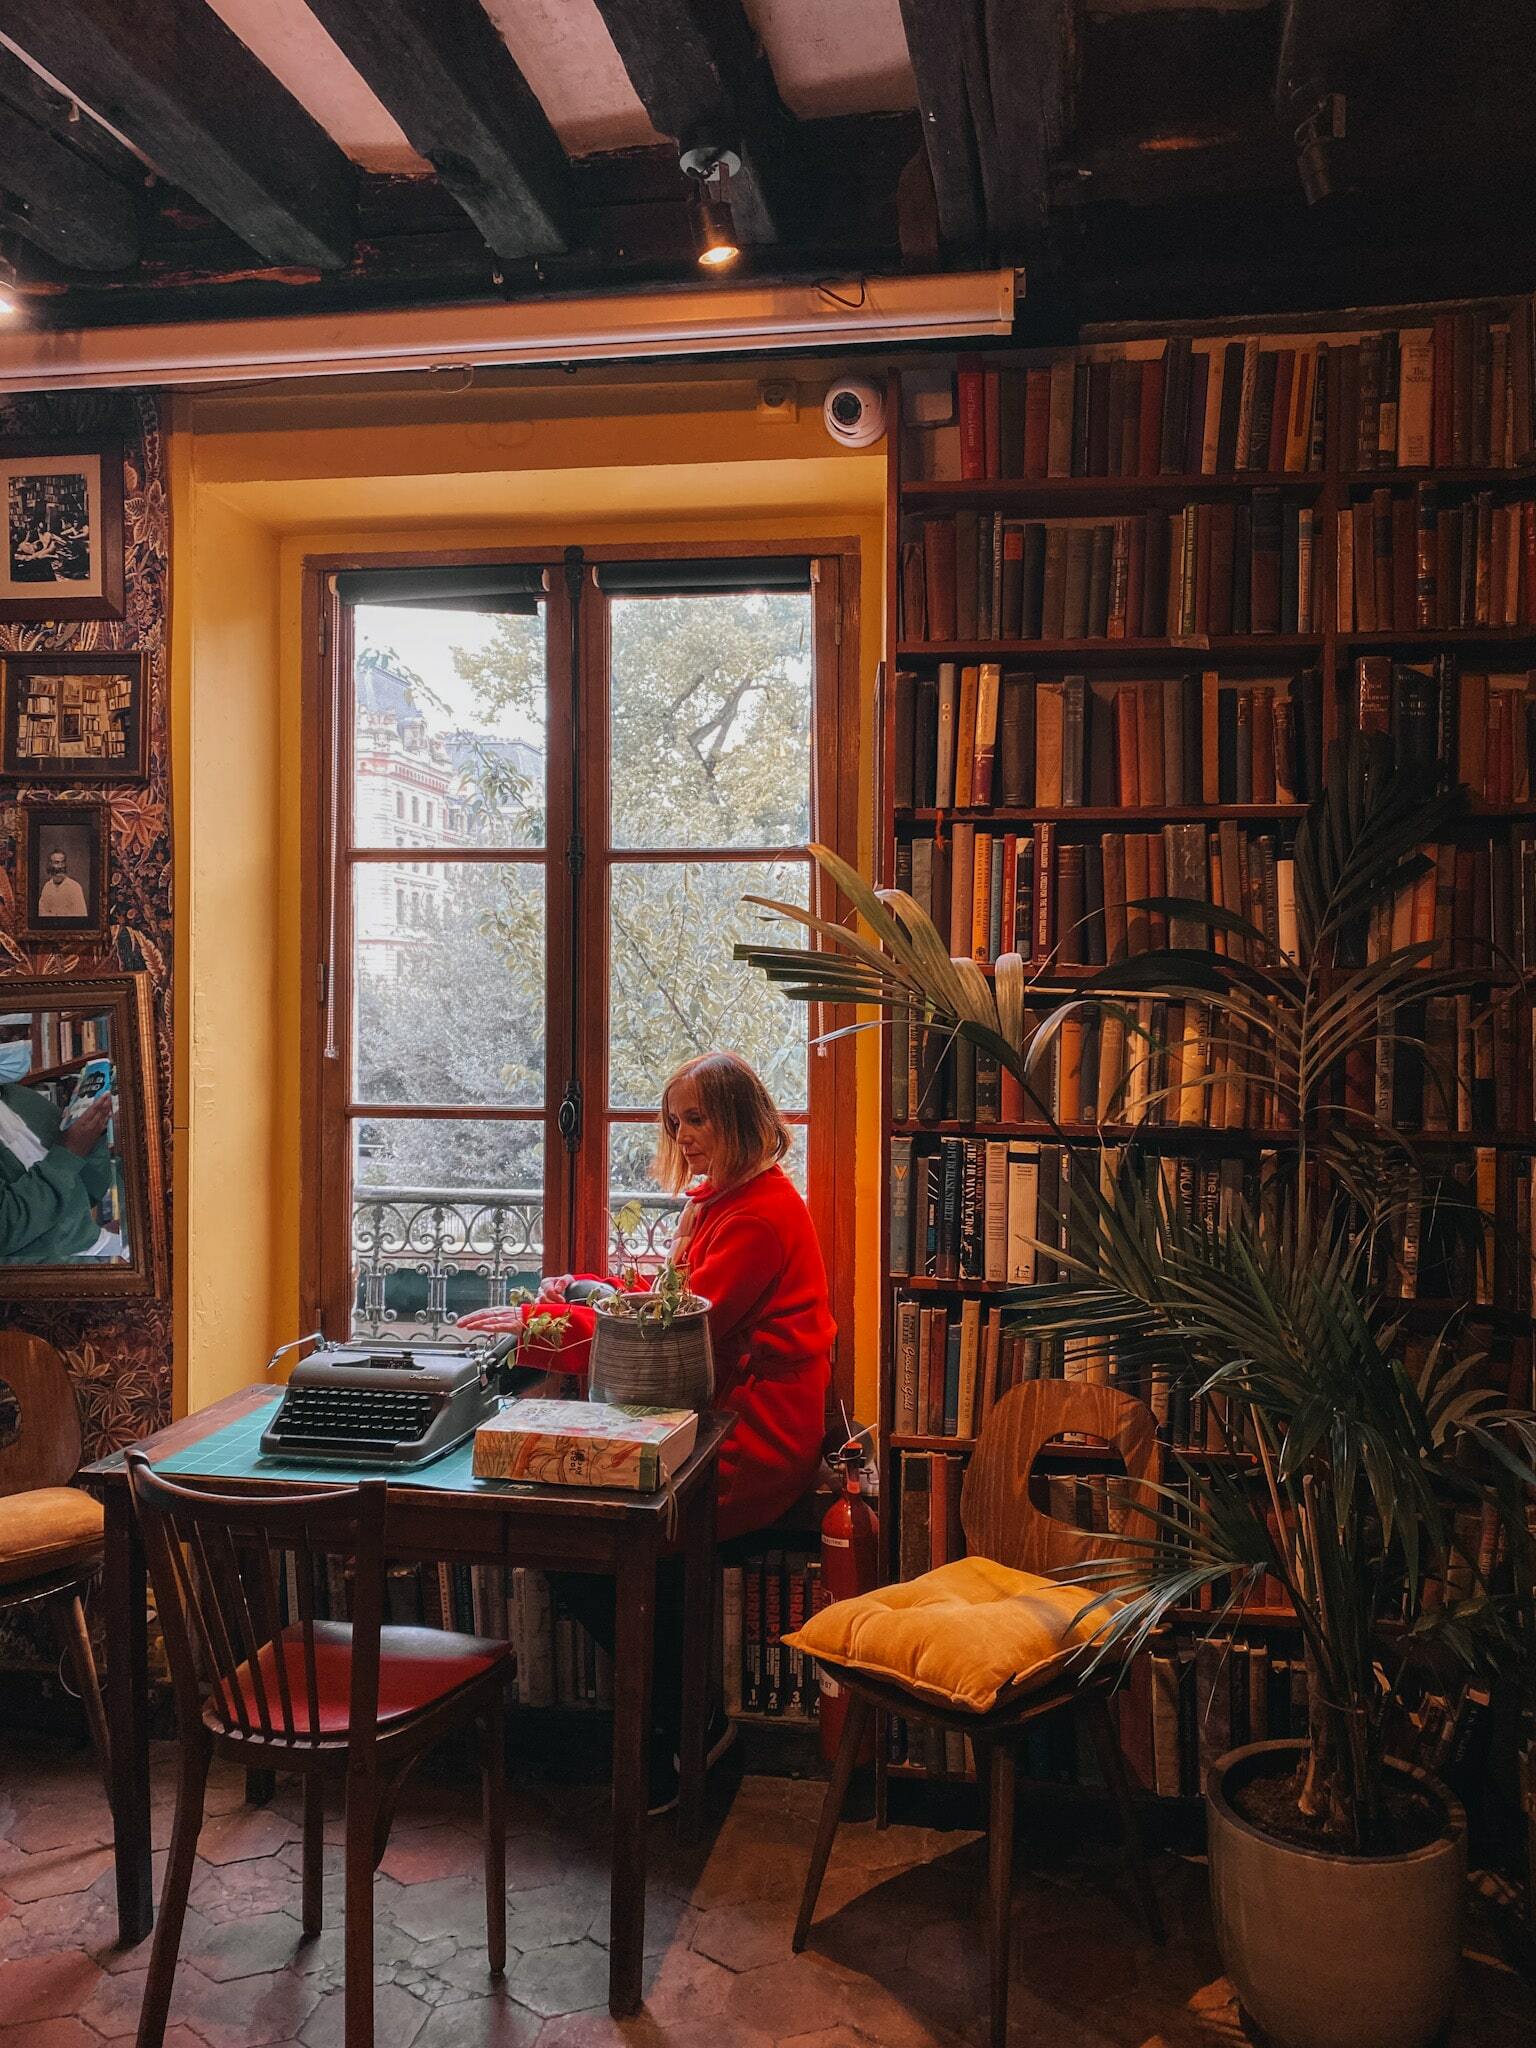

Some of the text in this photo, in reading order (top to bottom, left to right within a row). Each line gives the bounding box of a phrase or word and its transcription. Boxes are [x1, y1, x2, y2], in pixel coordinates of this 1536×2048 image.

[963, 1143, 976, 1235] THE HUMAN FACTOR
[902, 1344, 916, 1373] Good
[901, 1384, 914, 1411] Gold
[747, 1573, 761, 1641] HARRAP'S
[789, 1575, 804, 1632] HARRAP
